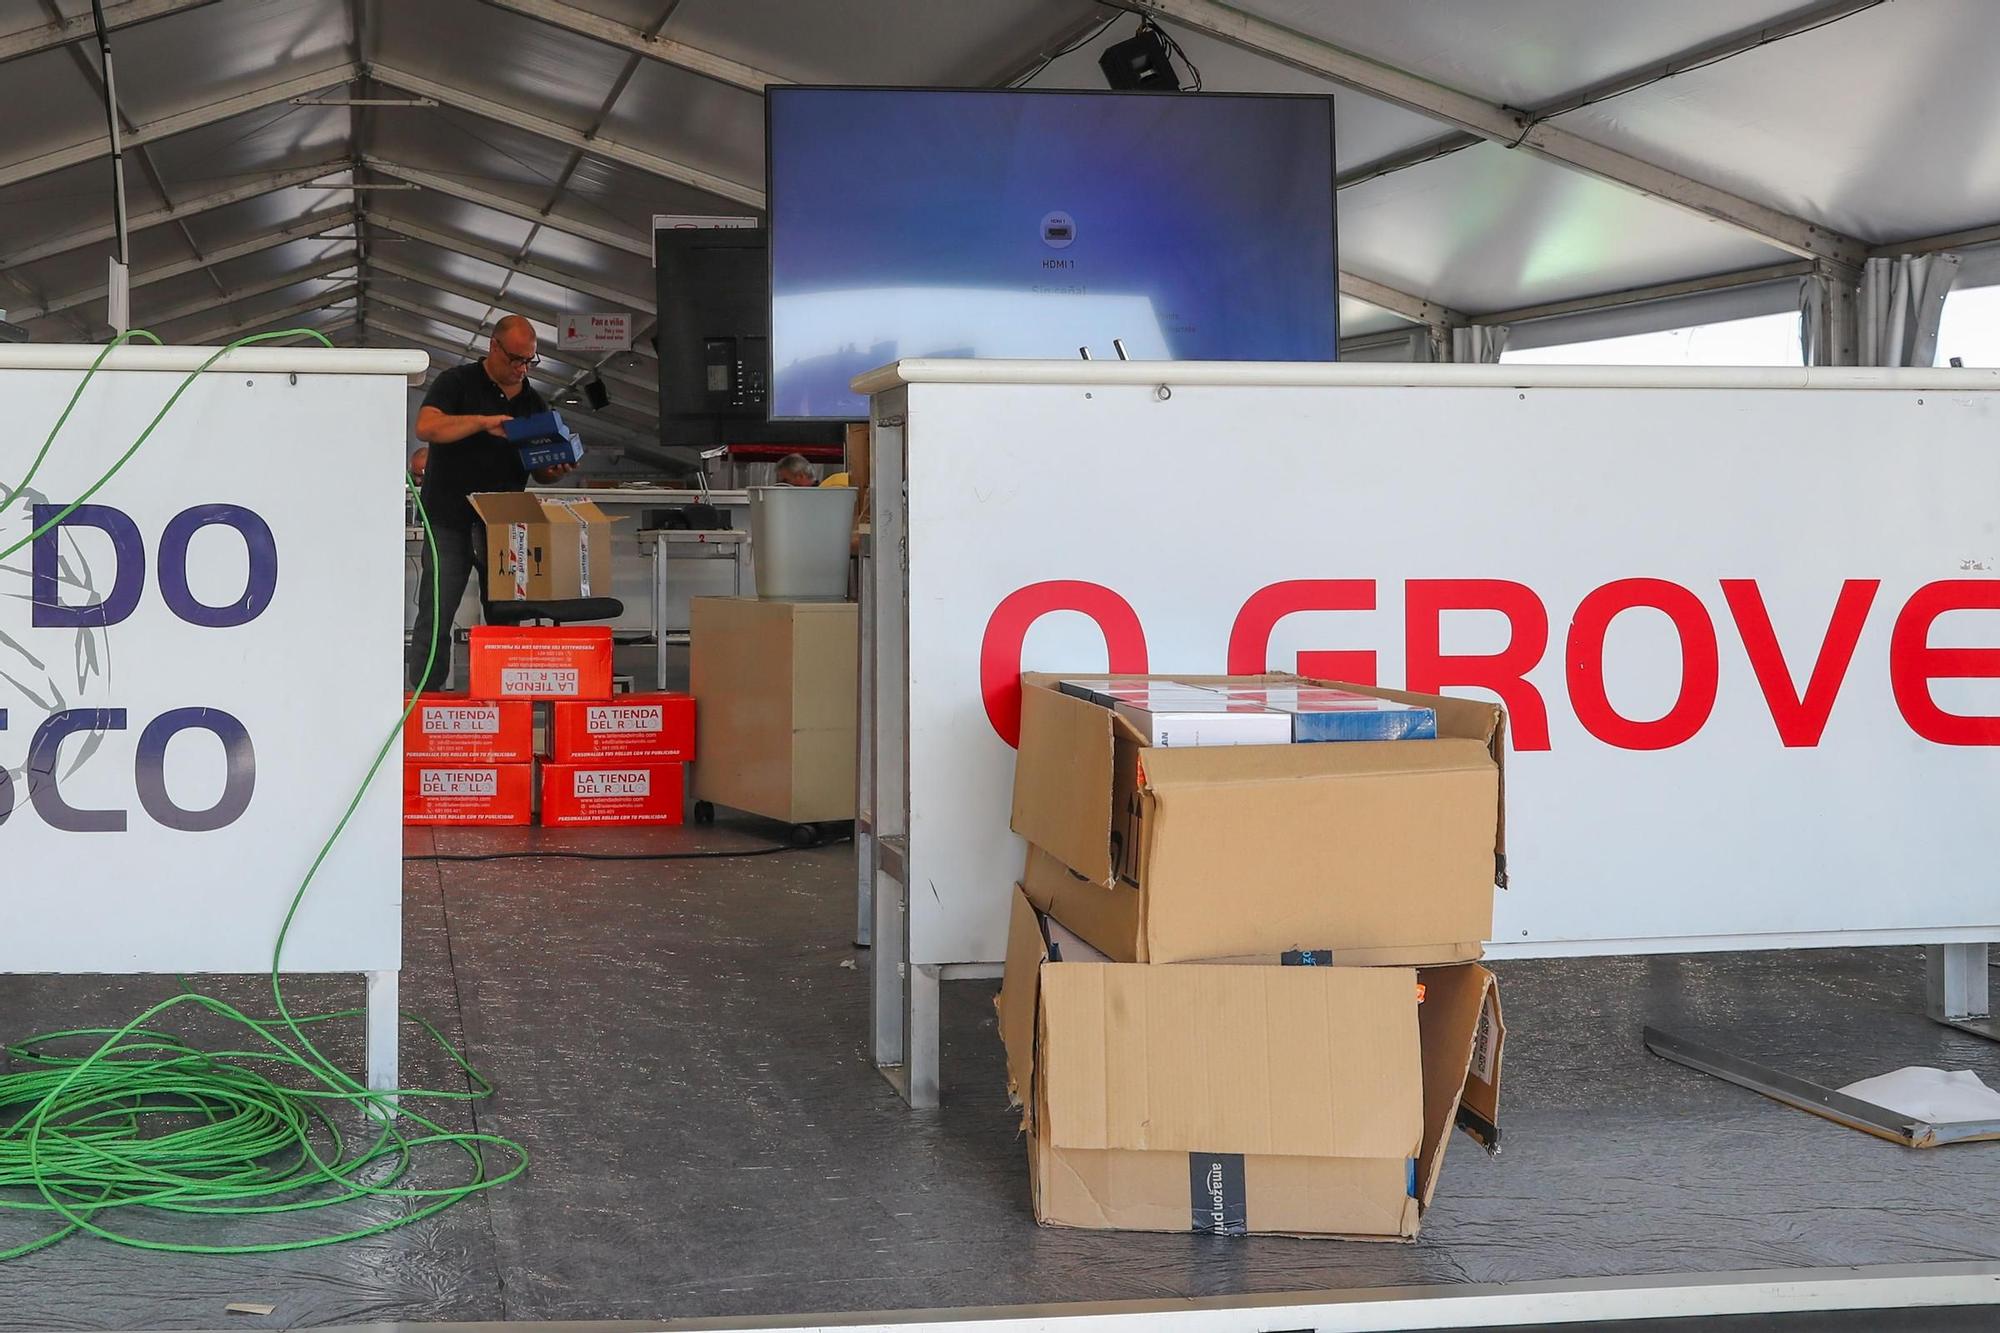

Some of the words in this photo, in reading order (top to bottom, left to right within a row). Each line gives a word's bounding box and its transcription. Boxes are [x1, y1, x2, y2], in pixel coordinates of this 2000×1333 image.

[1042, 260, 1067, 269] HDMI
[1070, 260, 1075, 269] 1
[1031, 285, 1051, 296] Sin
[592, 317, 603, 326] Pan
[32, 503, 278, 628] DO
[980, 579, 1149, 750] O
[1228, 577, 2000, 752] GROVE
[552, 672, 575, 680] DEL
[506, 682, 552, 691] TIENDA
[559, 682, 574, 691] LA
[426, 710, 442, 720] LA
[448, 710, 495, 720] TIENDA
[591, 710, 607, 719] LA
[612, 709, 659, 719] TIENDA
[425, 721, 448, 730] DEL
[590, 720, 612, 730] DEL
[424, 773, 440, 782] LA
[446, 773, 493, 782] TIENDA
[578, 774, 594, 783] LA
[599, 773, 646, 783] TIENDA
[423, 783, 446, 792] DEL
[577, 784, 600, 794] DEL
[1212, 1163, 1223, 1210] amazon
